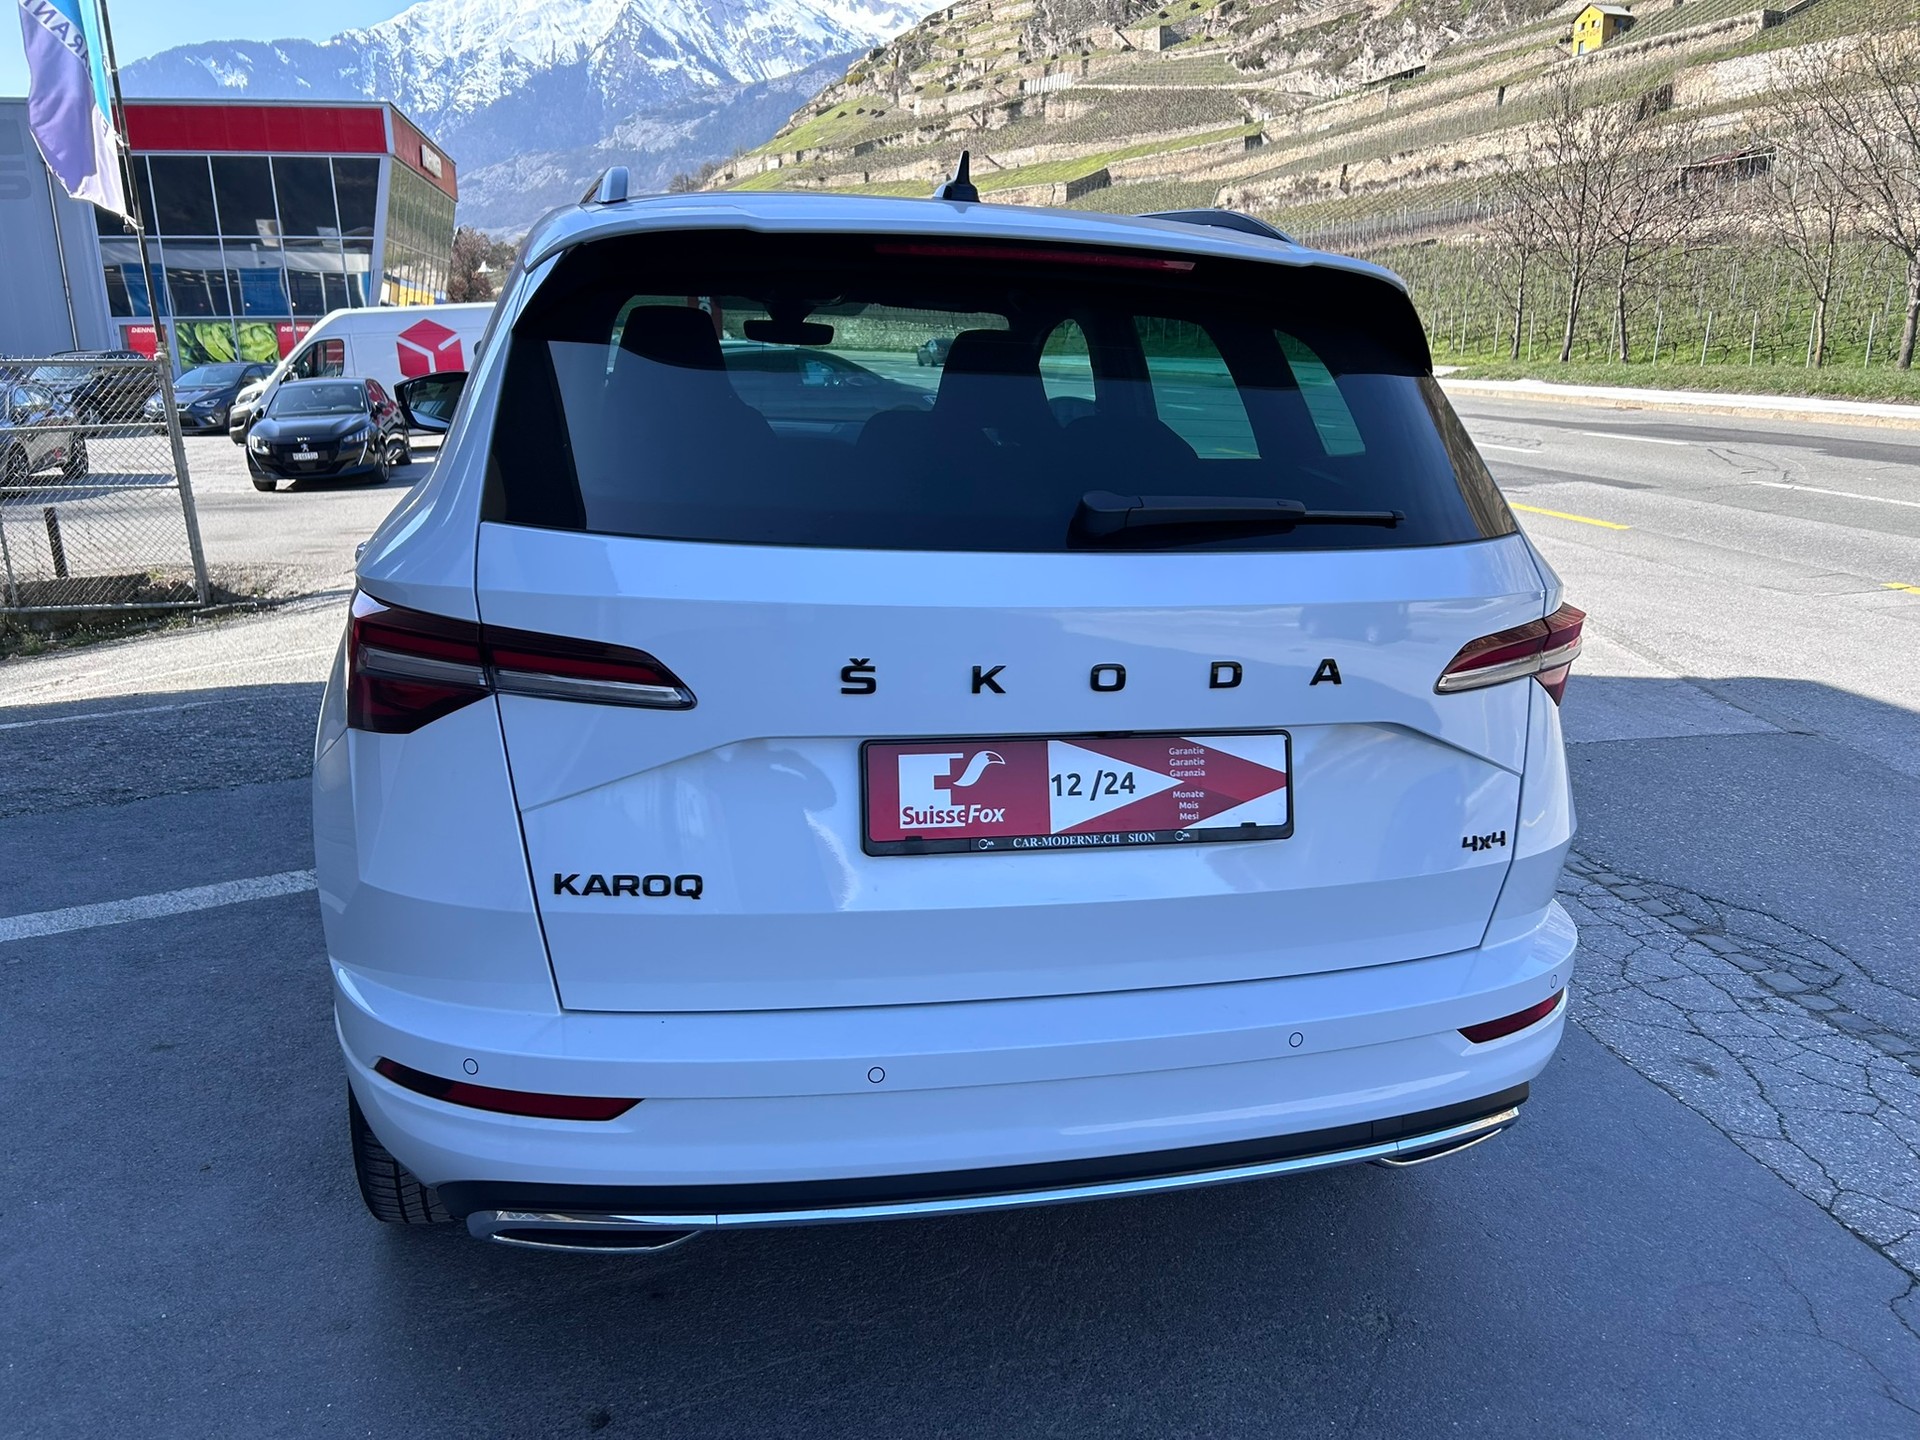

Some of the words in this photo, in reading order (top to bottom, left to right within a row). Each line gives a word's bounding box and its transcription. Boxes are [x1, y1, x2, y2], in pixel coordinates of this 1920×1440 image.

[840, 657, 1342, 695] ŠKODA
[1168, 746, 1205, 756] Garantie
[1169, 757, 1206, 767] Garantie
[1169, 768, 1206, 777] Garanzia
[1050, 773, 1082, 797] 12
[1172, 790, 1205, 799] Monate
[1178, 801, 1199, 809] Mois
[1179, 811, 1199, 820] Mesi
[1013, 834, 1120, 848] CAR-MODERNE.CH
[1128, 832, 1156, 843] SION
[1461, 830, 1506, 852] 4x4
[553, 873, 704, 900] KAROQ
